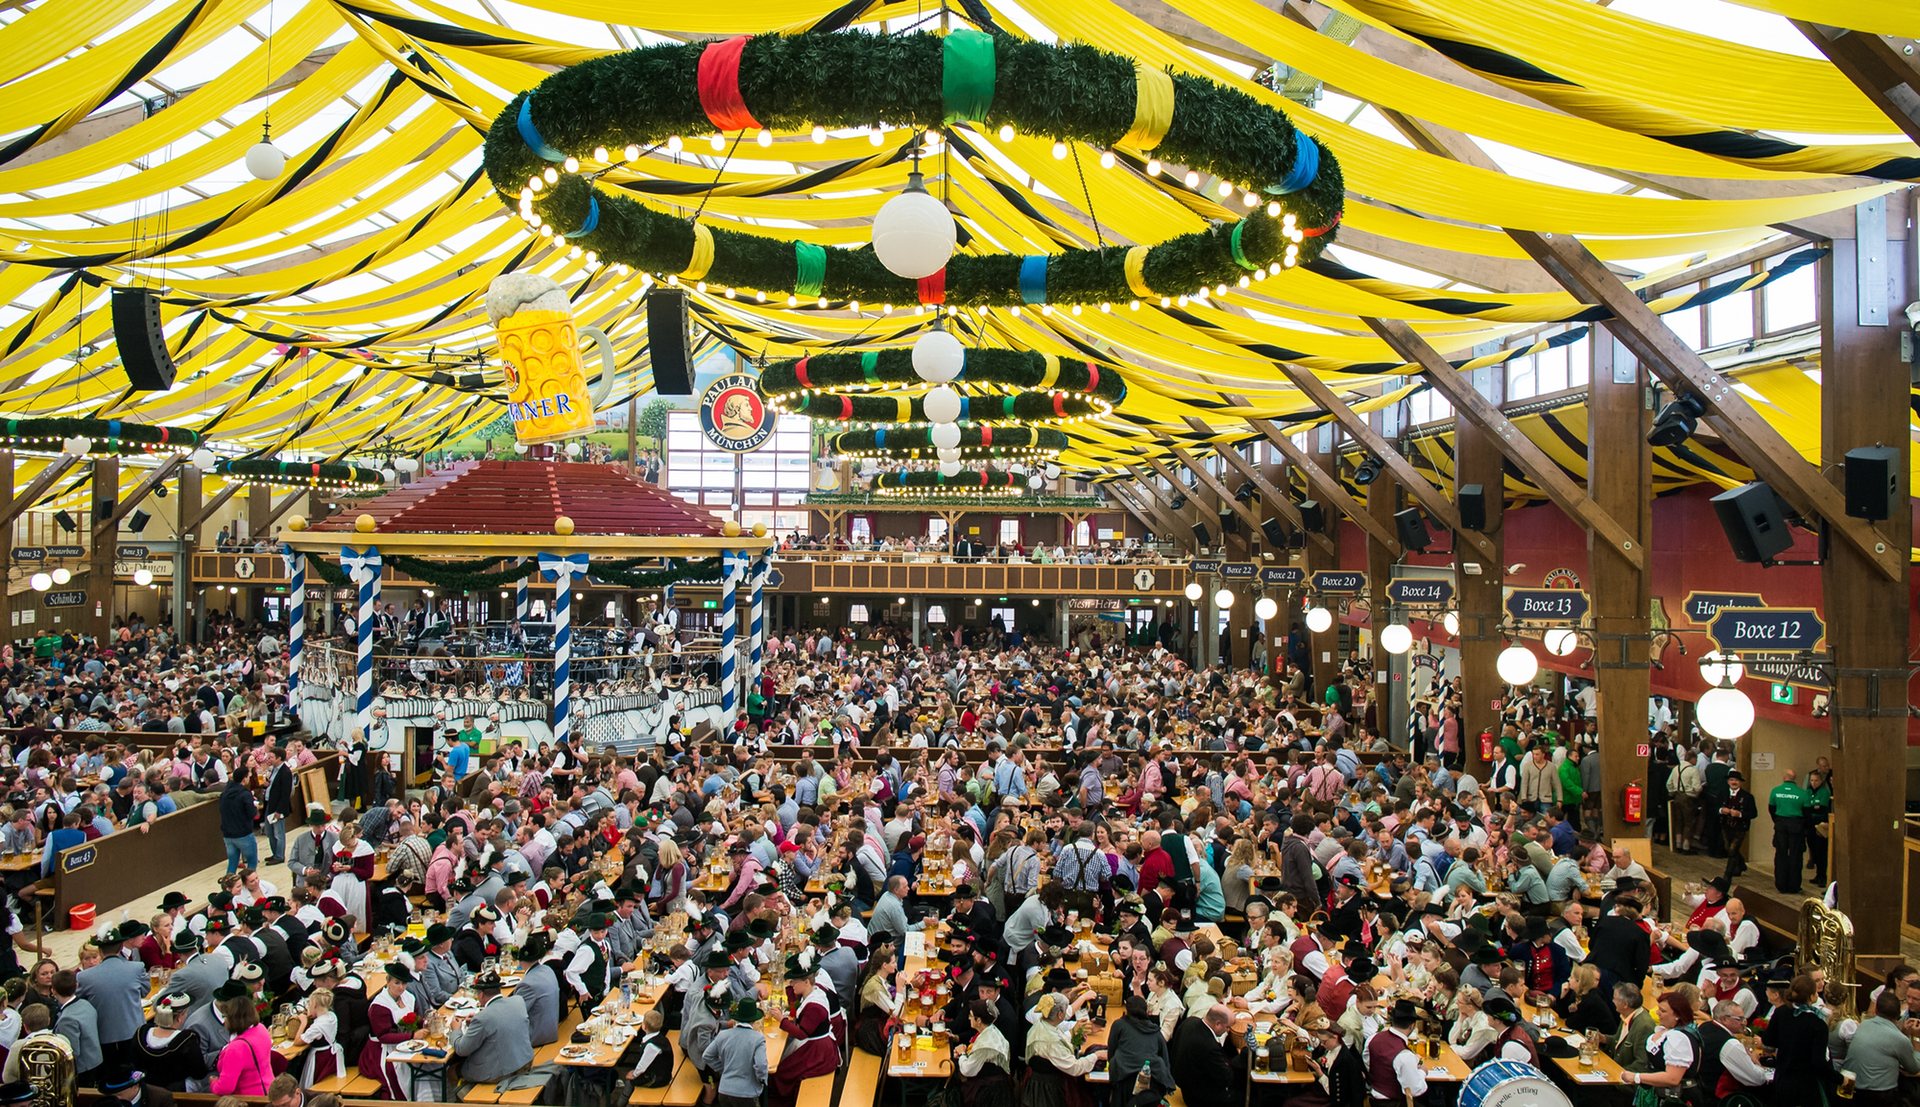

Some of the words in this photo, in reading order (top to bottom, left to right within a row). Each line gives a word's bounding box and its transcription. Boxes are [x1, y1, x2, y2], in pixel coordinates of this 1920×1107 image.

[702, 376, 759, 408] PAULAN
[707, 427, 768, 450] MÜNCHEN
[17, 550, 32, 558] Boxe
[32, 550, 41, 559] 32
[135, 549, 144, 557] 33
[1209, 563, 1218, 571] 23
[1226, 566, 1242, 574] Boxe
[1242, 566, 1252, 574] 22
[1268, 571, 1285, 579] Boxe
[1286, 571, 1297, 579] 21
[1322, 576, 1343, 586] Boxe
[1343, 576, 1356, 586] 20
[1546, 569, 1580, 586] PAULANER
[50, 593, 77, 605] Schänke
[77, 592, 82, 604] 3
[348, 588, 356, 599] 2
[1401, 585, 1426, 597] Boxe
[1427, 585, 1441, 599] 14
[1523, 598, 1555, 612] Boxe
[1556, 598, 1572, 615] 13
[1734, 621, 1776, 639] Boxe
[1779, 621, 1801, 639] 12
[70, 856, 83, 866] Boxe
[82, 851, 91, 863] 43
